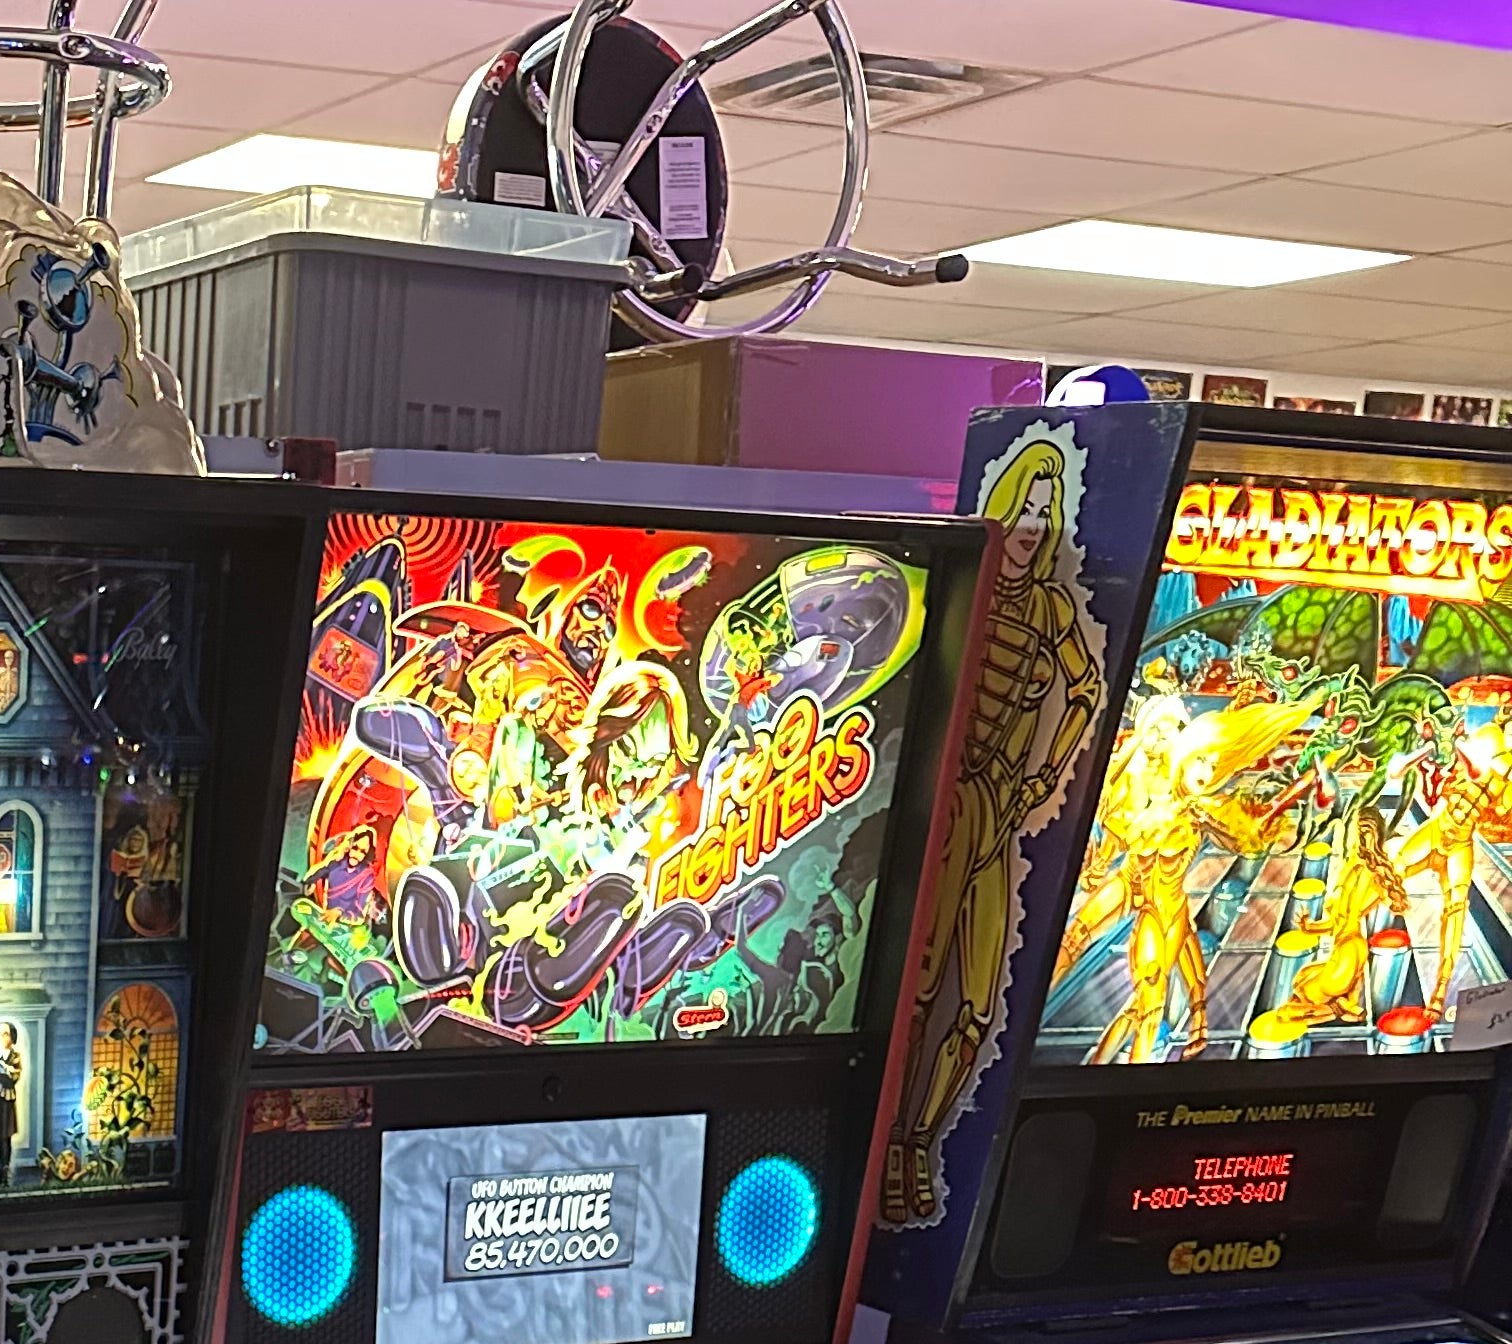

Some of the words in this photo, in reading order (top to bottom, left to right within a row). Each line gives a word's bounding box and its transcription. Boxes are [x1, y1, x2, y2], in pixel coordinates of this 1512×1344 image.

[1164, 484, 1512, 582] GLADIATORS
[707, 697, 818, 828] FOO
[656, 711, 870, 908] FIGHTERS
[679, 1009, 723, 1027] Stern
[1137, 1111, 1168, 1128] THE
[1170, 1104, 1243, 1126] Premier
[1244, 1105, 1294, 1122] NAME
[1294, 1104, 1313, 1120] IN
[1314, 1101, 1376, 1119] PINBALL
[1194, 1154, 1294, 1180] TELEPHONE
[471, 1180, 497, 1199] UFO
[499, 1176, 548, 1197] BUTTON
[549, 1171, 615, 1193] CHAMPION
[1167, 1239, 1282, 1276] Gottlieb
